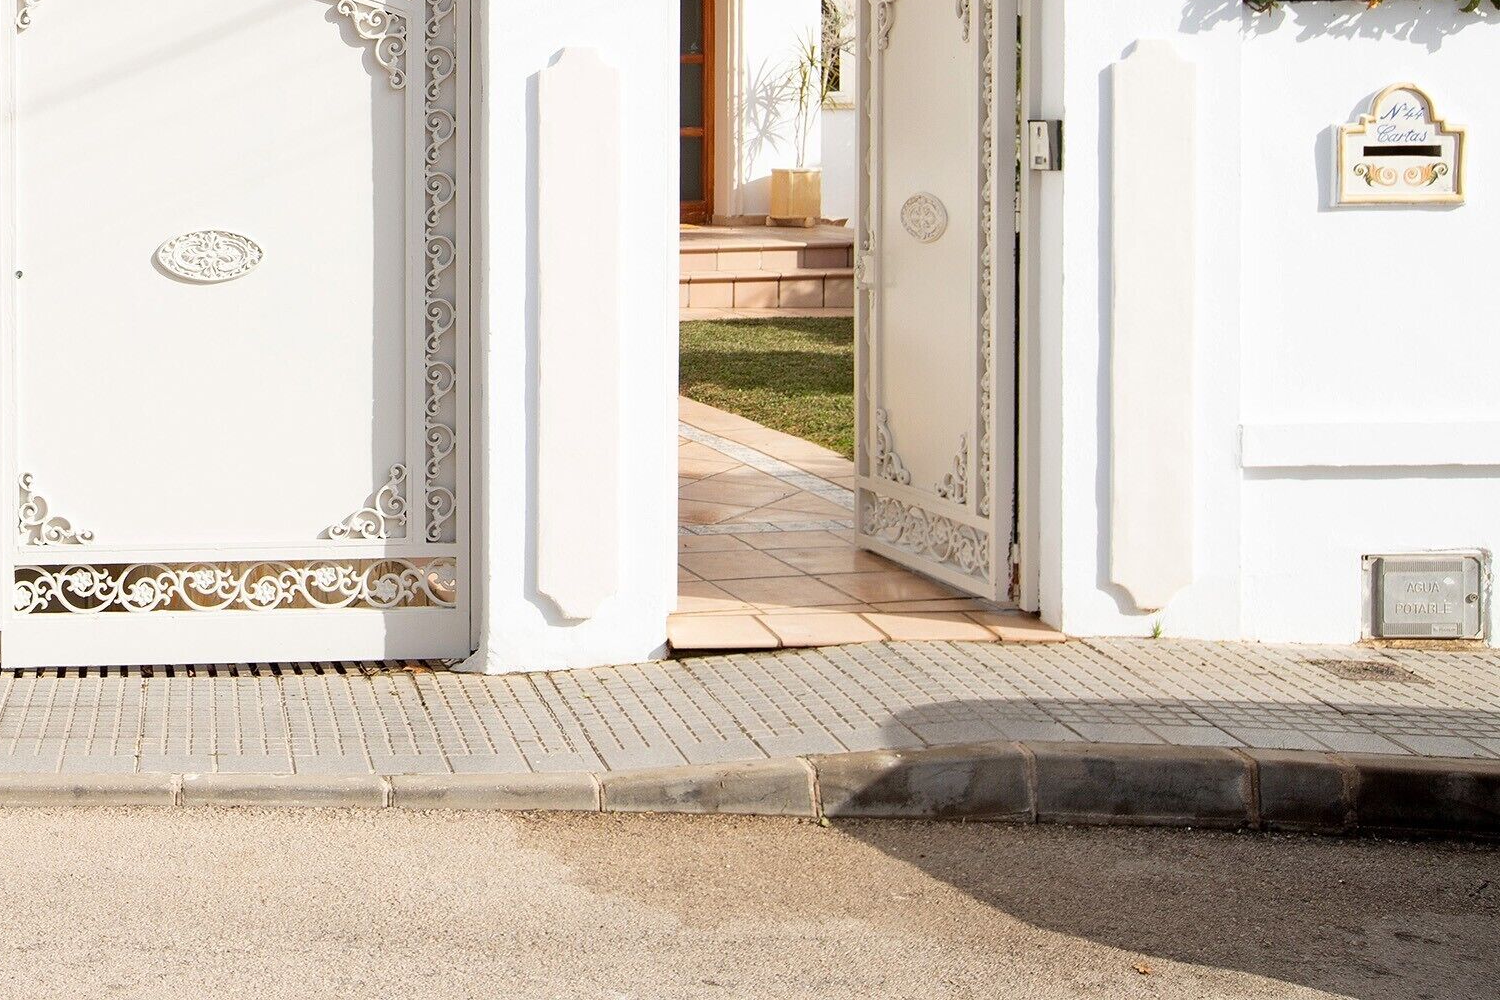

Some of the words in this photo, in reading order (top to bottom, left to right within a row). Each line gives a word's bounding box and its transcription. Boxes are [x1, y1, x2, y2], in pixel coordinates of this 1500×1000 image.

[1377, 124, 1428, 143] Cartas
[1406, 581, 1440, 593] AGUA
[1395, 602, 1453, 615] POTABLE
